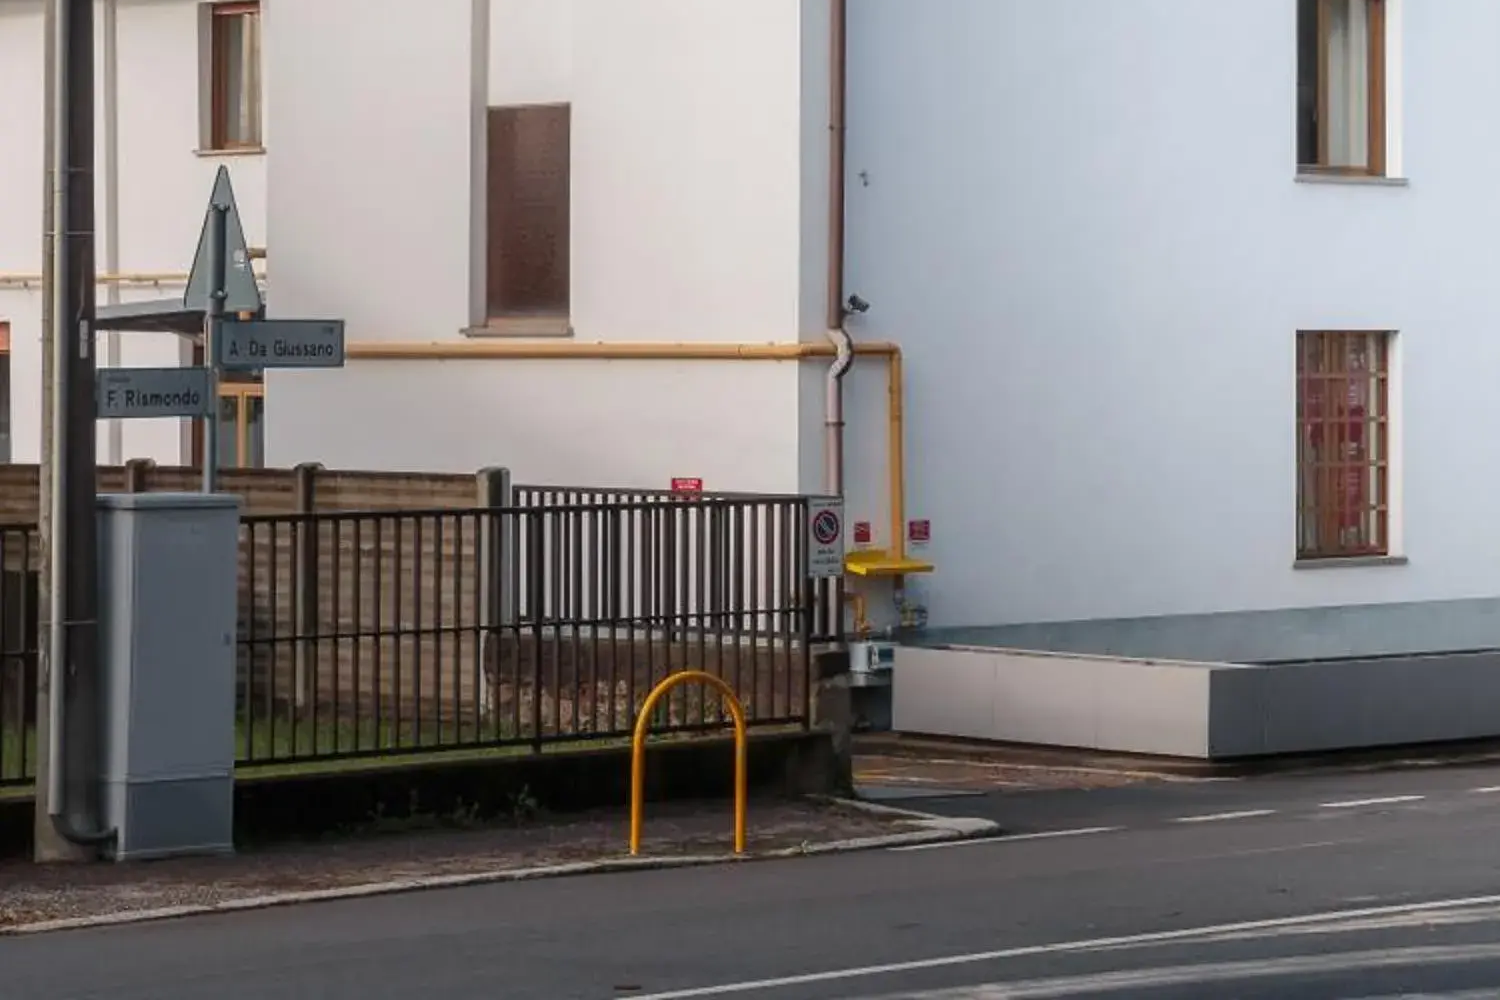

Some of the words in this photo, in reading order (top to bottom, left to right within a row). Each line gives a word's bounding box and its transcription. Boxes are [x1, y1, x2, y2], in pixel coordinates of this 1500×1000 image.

[249, 340, 267, 357] Da
[273, 338, 334, 357] Giussano
[125, 387, 200, 408] Rismondo
